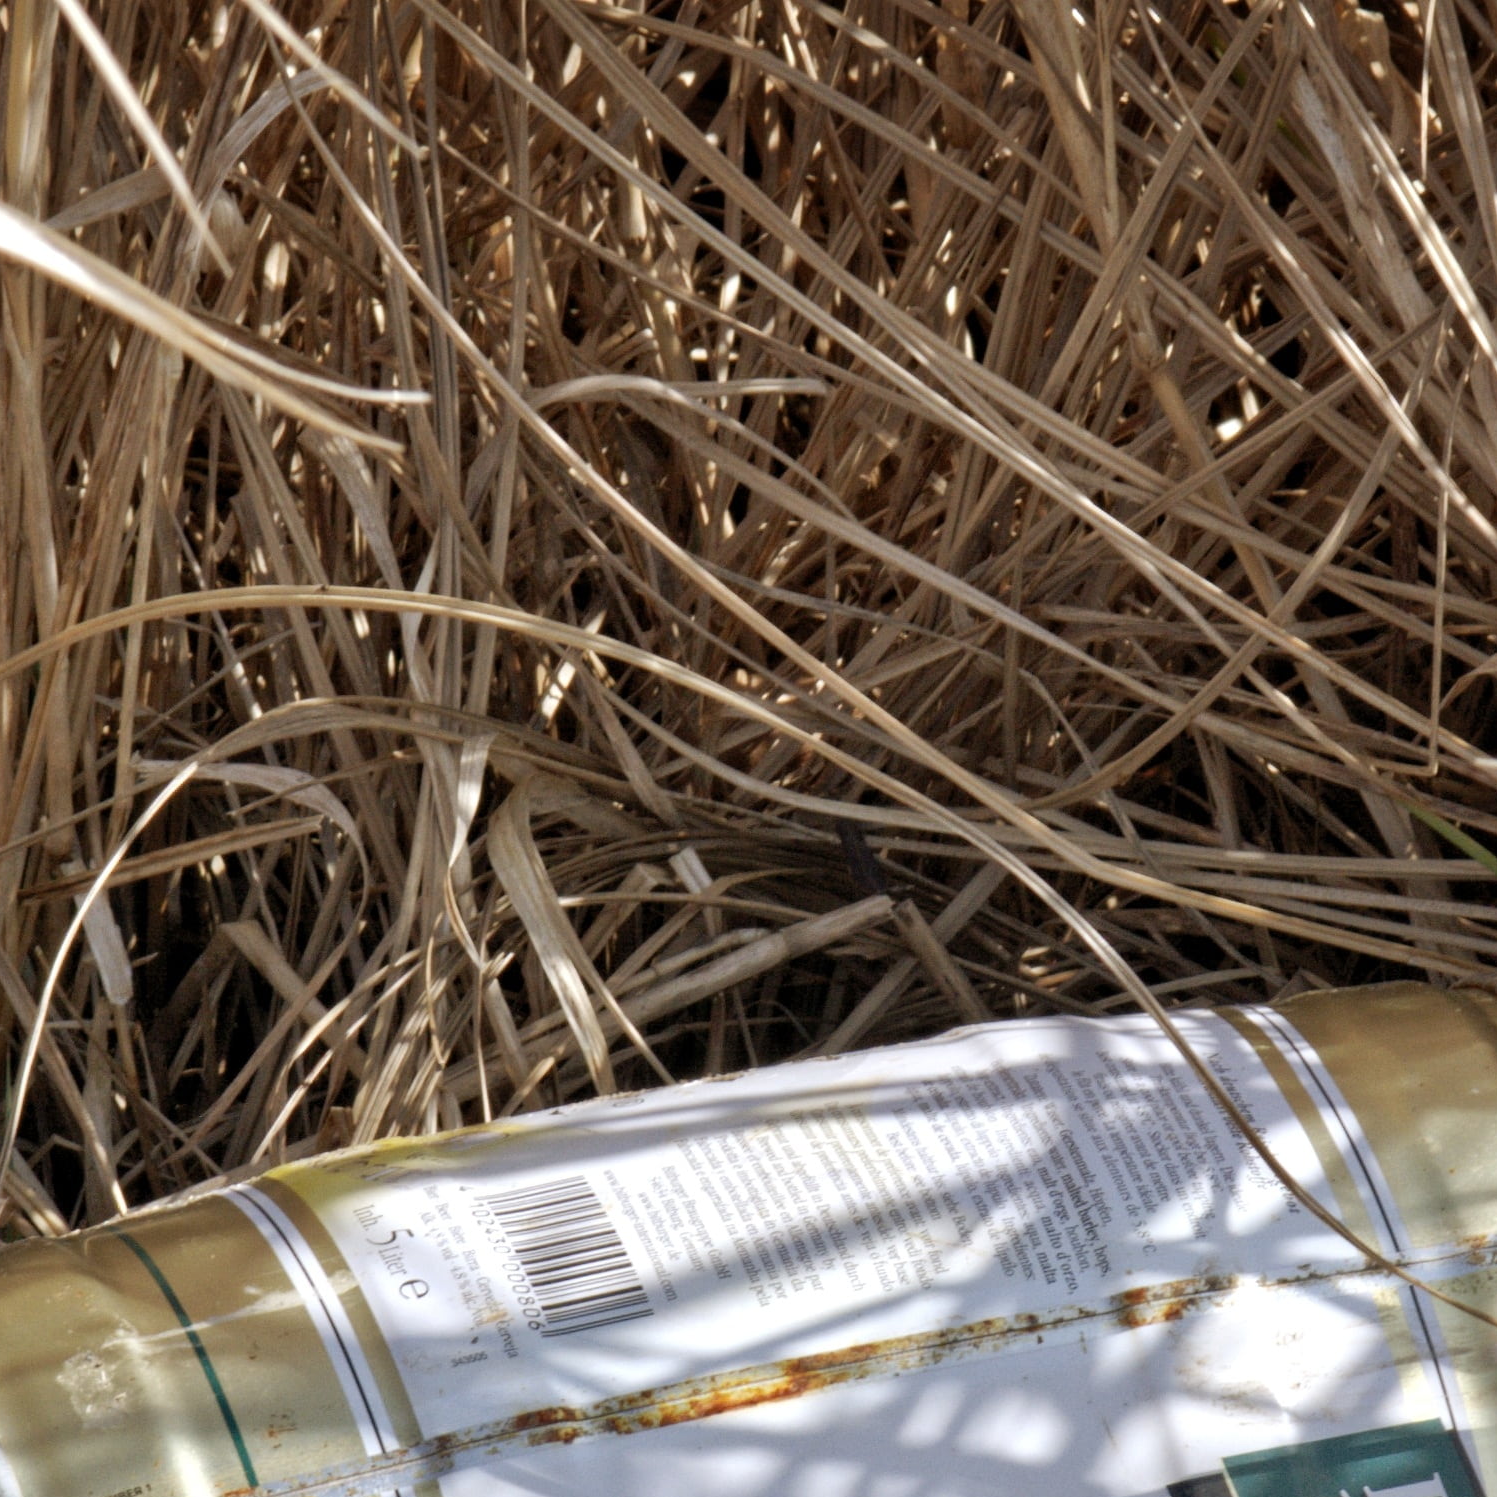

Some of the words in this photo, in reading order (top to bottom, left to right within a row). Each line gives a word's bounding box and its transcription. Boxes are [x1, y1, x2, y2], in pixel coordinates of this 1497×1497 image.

[1100, 1153, 1131, 1201] alentours
[1124, 1203, 1139, 1217] de
[350, 1204, 383, 1231] Inh.
[1035, 1167, 1057, 1188] malt
[1047, 1189, 1068, 1222] d'orge,
[1064, 1225, 1091, 1273] houblon,
[1060, 1173, 1088, 1208] malted
[1077, 1208, 1099, 1246] barley,
[1092, 1245, 1111, 1275] hops,
[1089, 1187, 1113, 1226] Hopfen,
[366, 1228, 414, 1246] 5
[799, 1215, 828, 1258] Germany
[820, 1257, 835, 1271] by
[813, 1204, 852, 1260] Deutschland
[841, 1260, 866, 1291] durch
[1040, 1216, 1063, 1249] malto
[1055, 1250, 1079, 1297] d'orzo,
[375, 1245, 406, 1277] Liter
[706, 1248, 731, 1279] GmbH
[730, 1235, 761, 1284] Alemanha
[749, 1284, 771, 1307] pela
[749, 1235, 779, 1280] Alemania
[767, 1281, 786, 1300] por
[873, 1260, 894, 1292] fundo
[885, 1245, 898, 1260] ver
[892, 1261, 909, 1285] base
[927, 1249, 948, 1274] fond
[1038, 1251, 1059, 1285] malta
[500, 1260, 547, 1332] 000806
[789, 1277, 803, 1292] da
[804, 1273, 822, 1291] par
